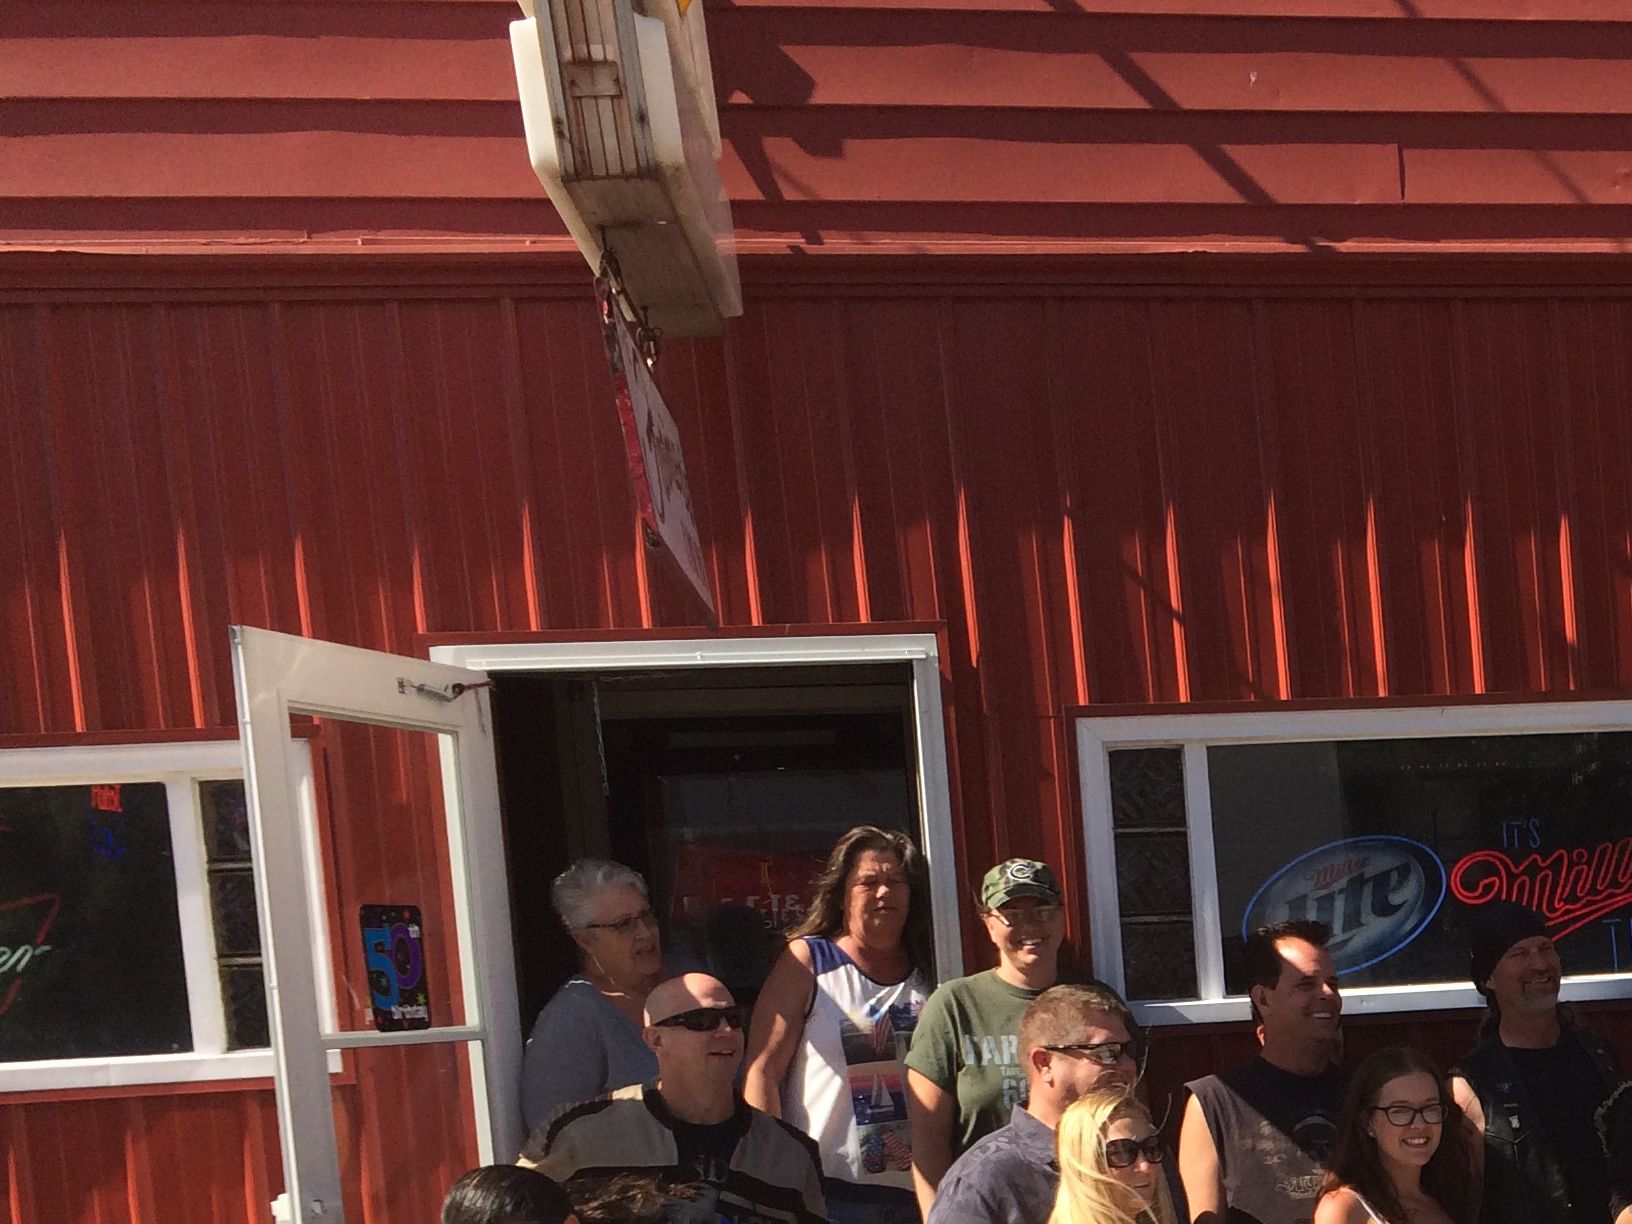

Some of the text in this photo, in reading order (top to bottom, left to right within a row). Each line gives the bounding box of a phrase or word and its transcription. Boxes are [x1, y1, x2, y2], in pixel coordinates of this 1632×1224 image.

[1503, 817, 1541, 849] IT'S
[1303, 856, 1371, 891] Miller
[363, 922, 422, 1011] 50
